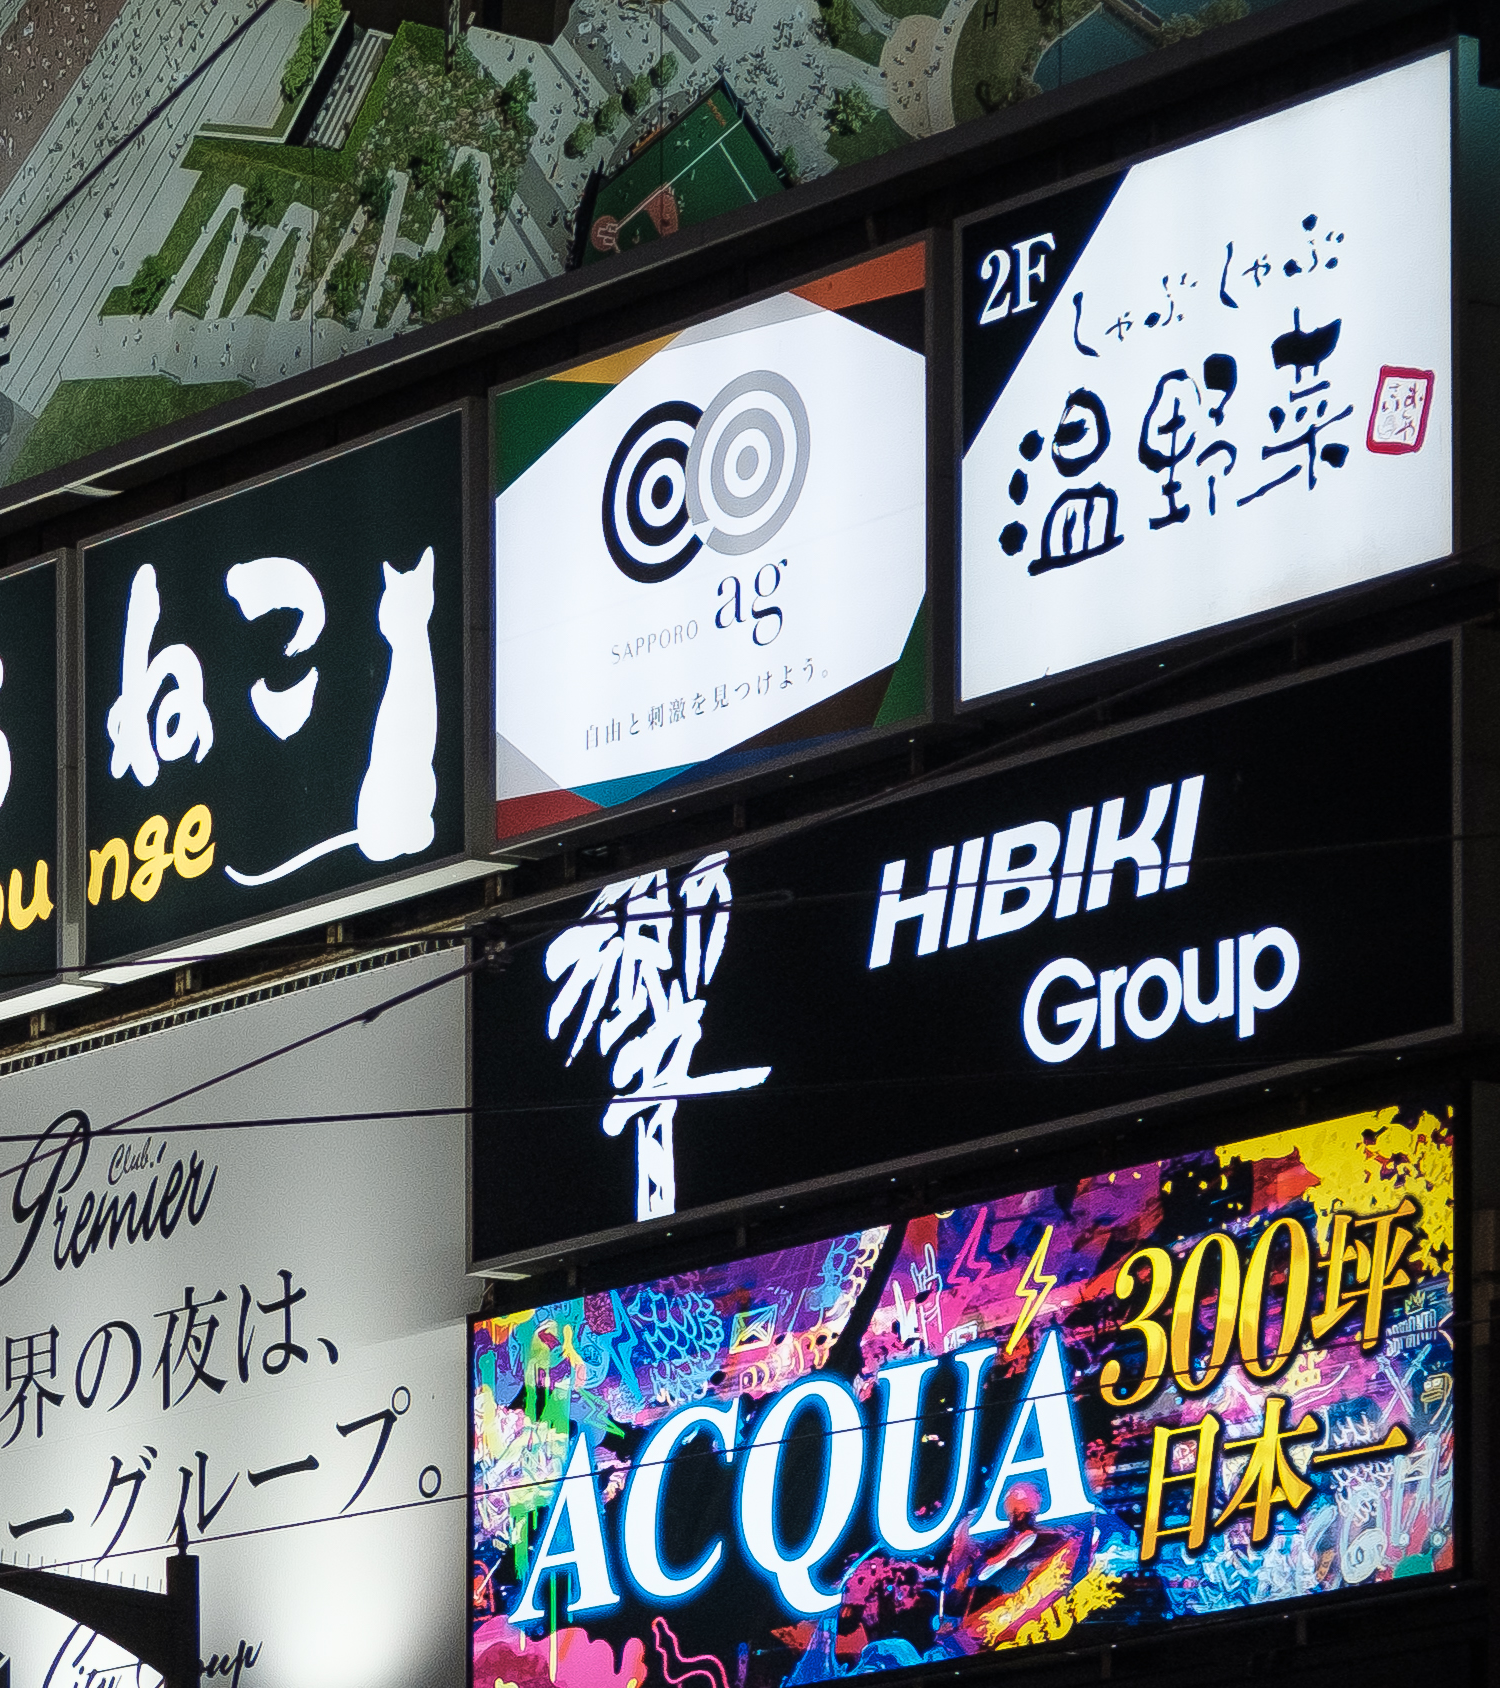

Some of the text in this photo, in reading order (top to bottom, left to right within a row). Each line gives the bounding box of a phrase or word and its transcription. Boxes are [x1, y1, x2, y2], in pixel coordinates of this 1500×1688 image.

[980, 233, 1057, 326] 2F
[1072, 213, 1346, 357] しゃぶしゃぶ
[1000, 309, 1352, 577] 温野菜
[611, 556, 789, 667] SAPPORO ag
[583, 659, 832, 753] 自由と刺激を見つけよう。
[869, 774, 1205, 971] HIBIKI
[1022, 928, 1300, 1065] Group
[1101, 1194, 1423, 1412] 300坪
[508, 1330, 1098, 1624] ACQUA
[1141, 1395, 1409, 1562] 日本一
